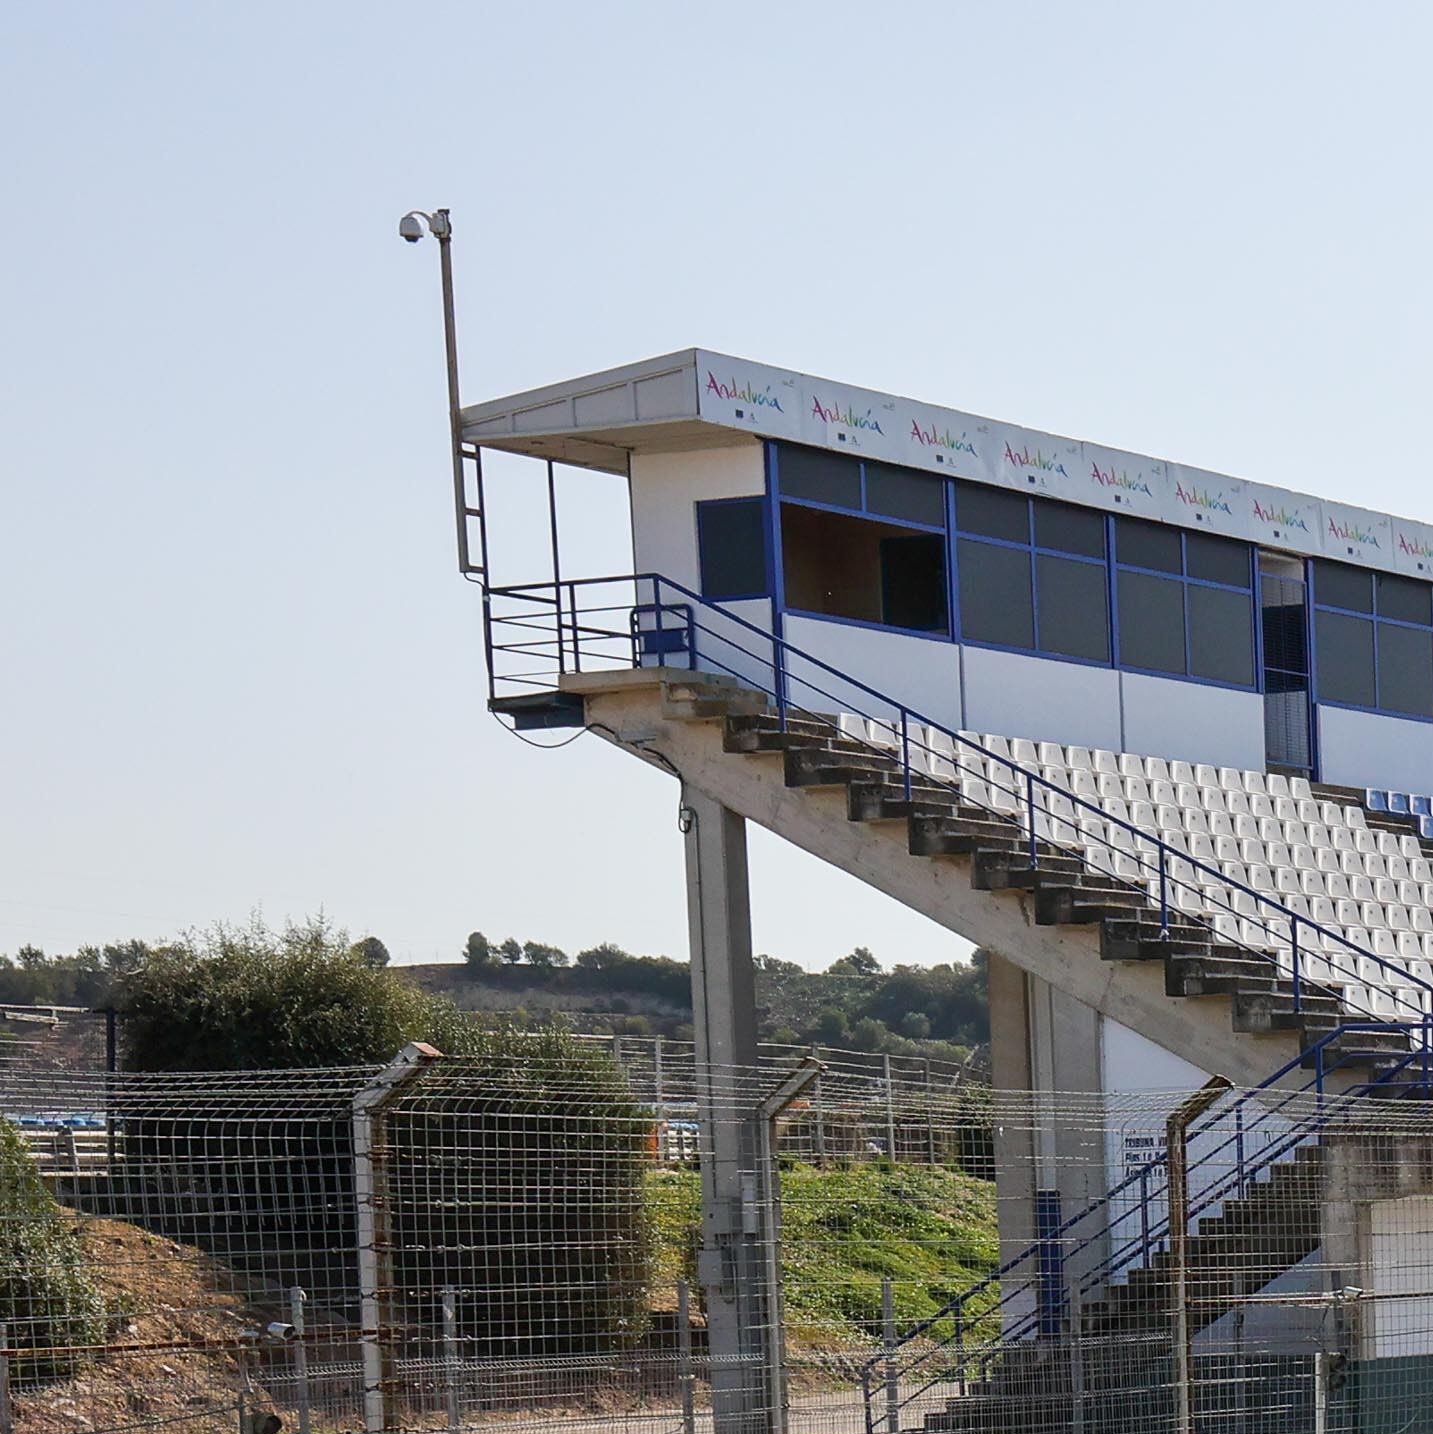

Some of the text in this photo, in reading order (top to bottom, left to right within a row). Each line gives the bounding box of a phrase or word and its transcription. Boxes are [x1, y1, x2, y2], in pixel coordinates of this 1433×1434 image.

[706, 370, 785, 413] Andalucía
[811, 395, 884, 436] Andalucía
[911, 419, 977, 457] Andalucía
[1004, 440, 1068, 477] Andalucía
[1091, 462, 1152, 497] Andalucía
[1175, 482, 1232, 515] Andalucía
[1252, 497, 1310, 531] Andalucía
